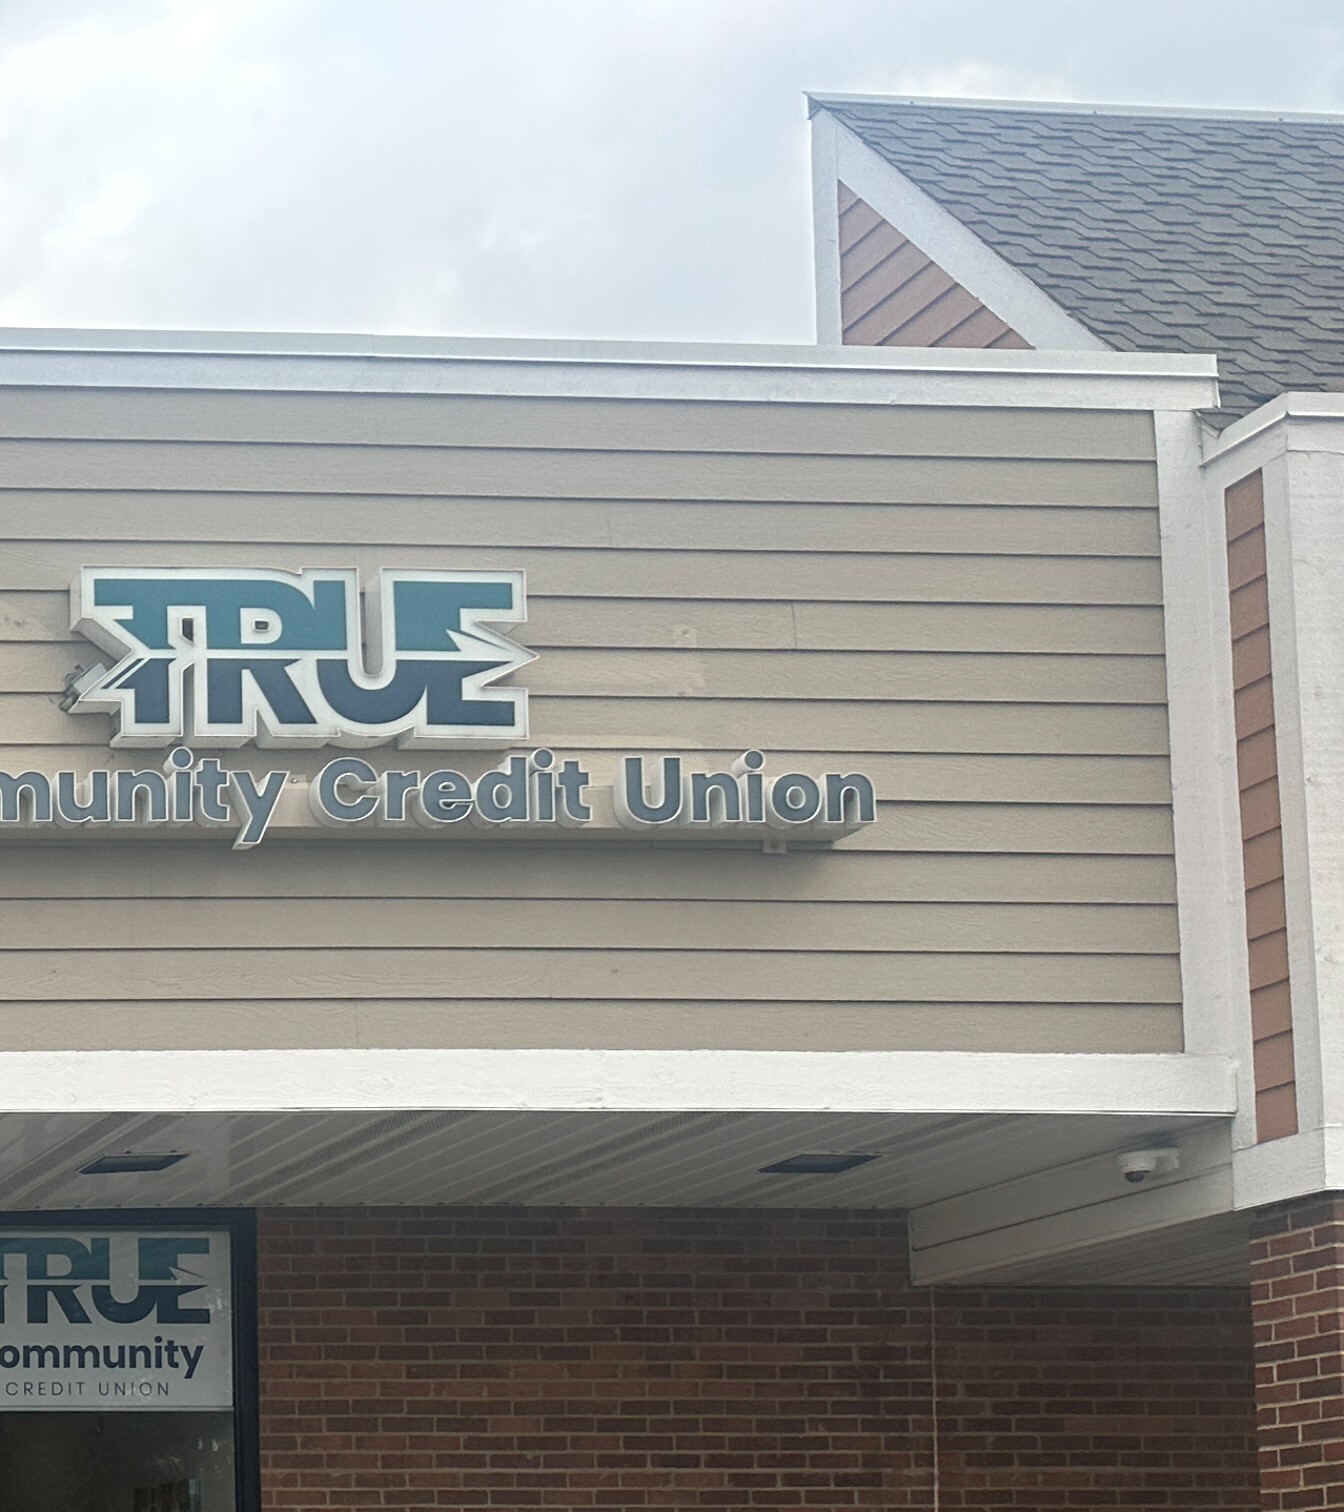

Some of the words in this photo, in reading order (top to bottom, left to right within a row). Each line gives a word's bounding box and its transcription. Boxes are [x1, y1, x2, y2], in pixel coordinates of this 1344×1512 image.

[82, 567, 536, 738] TRUE
[315, 748, 593, 829] Credit
[621, 748, 878, 826] Union
[5, 1381, 86, 1396] CREDIT
[98, 1381, 170, 1396] UNION
